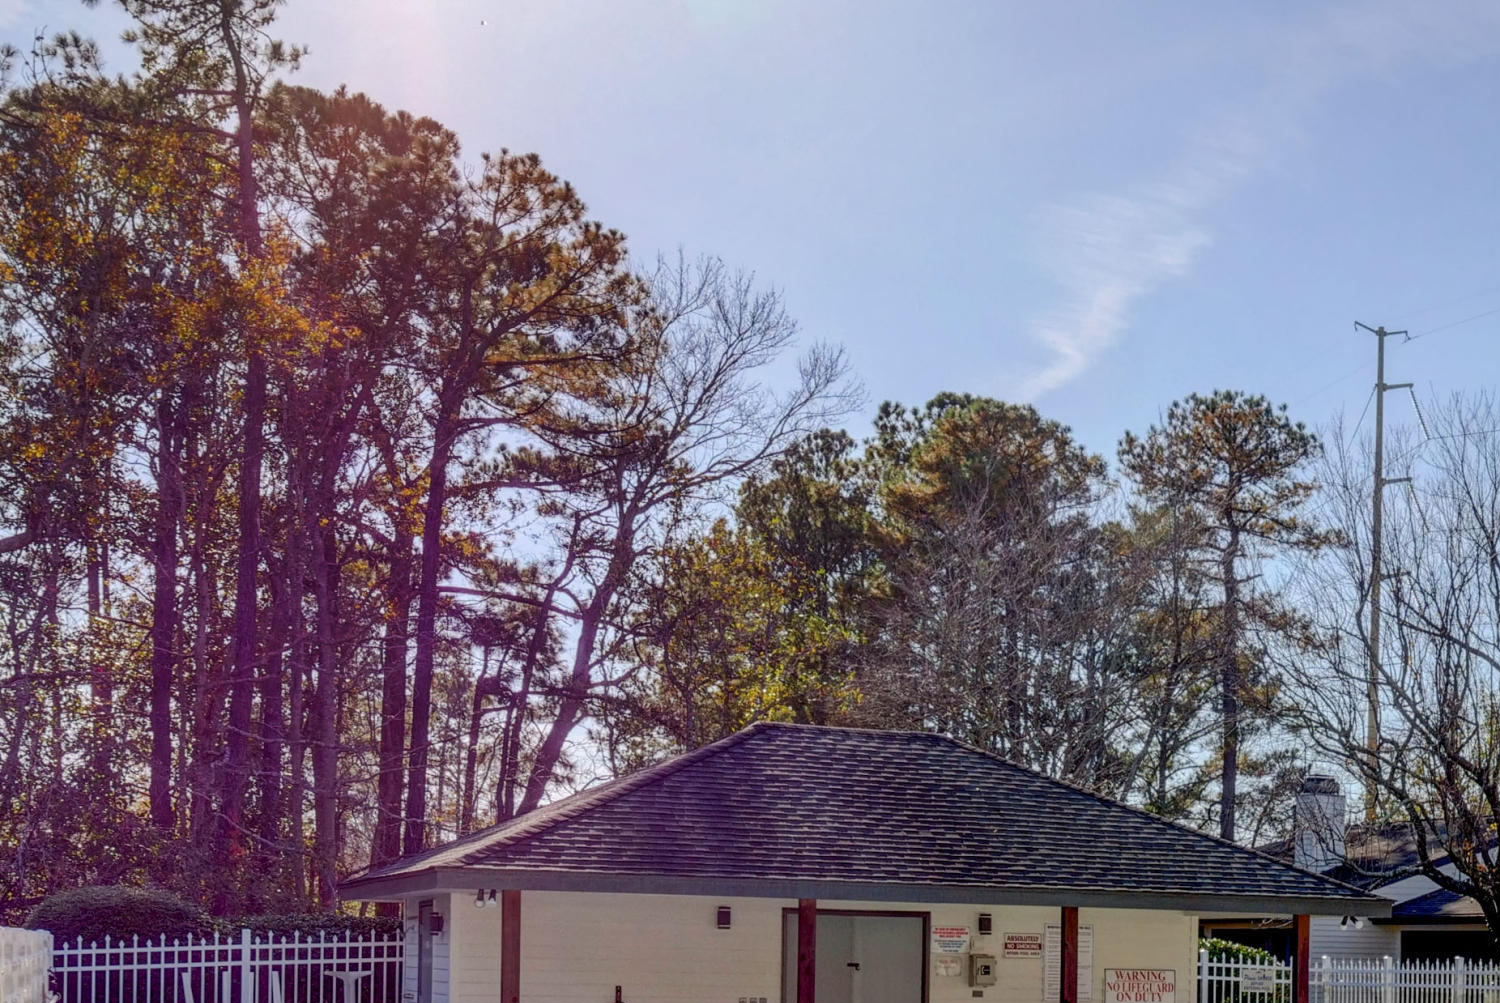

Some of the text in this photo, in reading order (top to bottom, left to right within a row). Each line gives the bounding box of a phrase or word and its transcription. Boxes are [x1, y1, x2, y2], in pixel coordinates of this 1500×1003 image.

[1115, 970, 1166, 981] WARNING
[1107, 982, 1174, 993] NO LIFEGUARD
[1116, 992, 1164, 1002] ON DUTY
